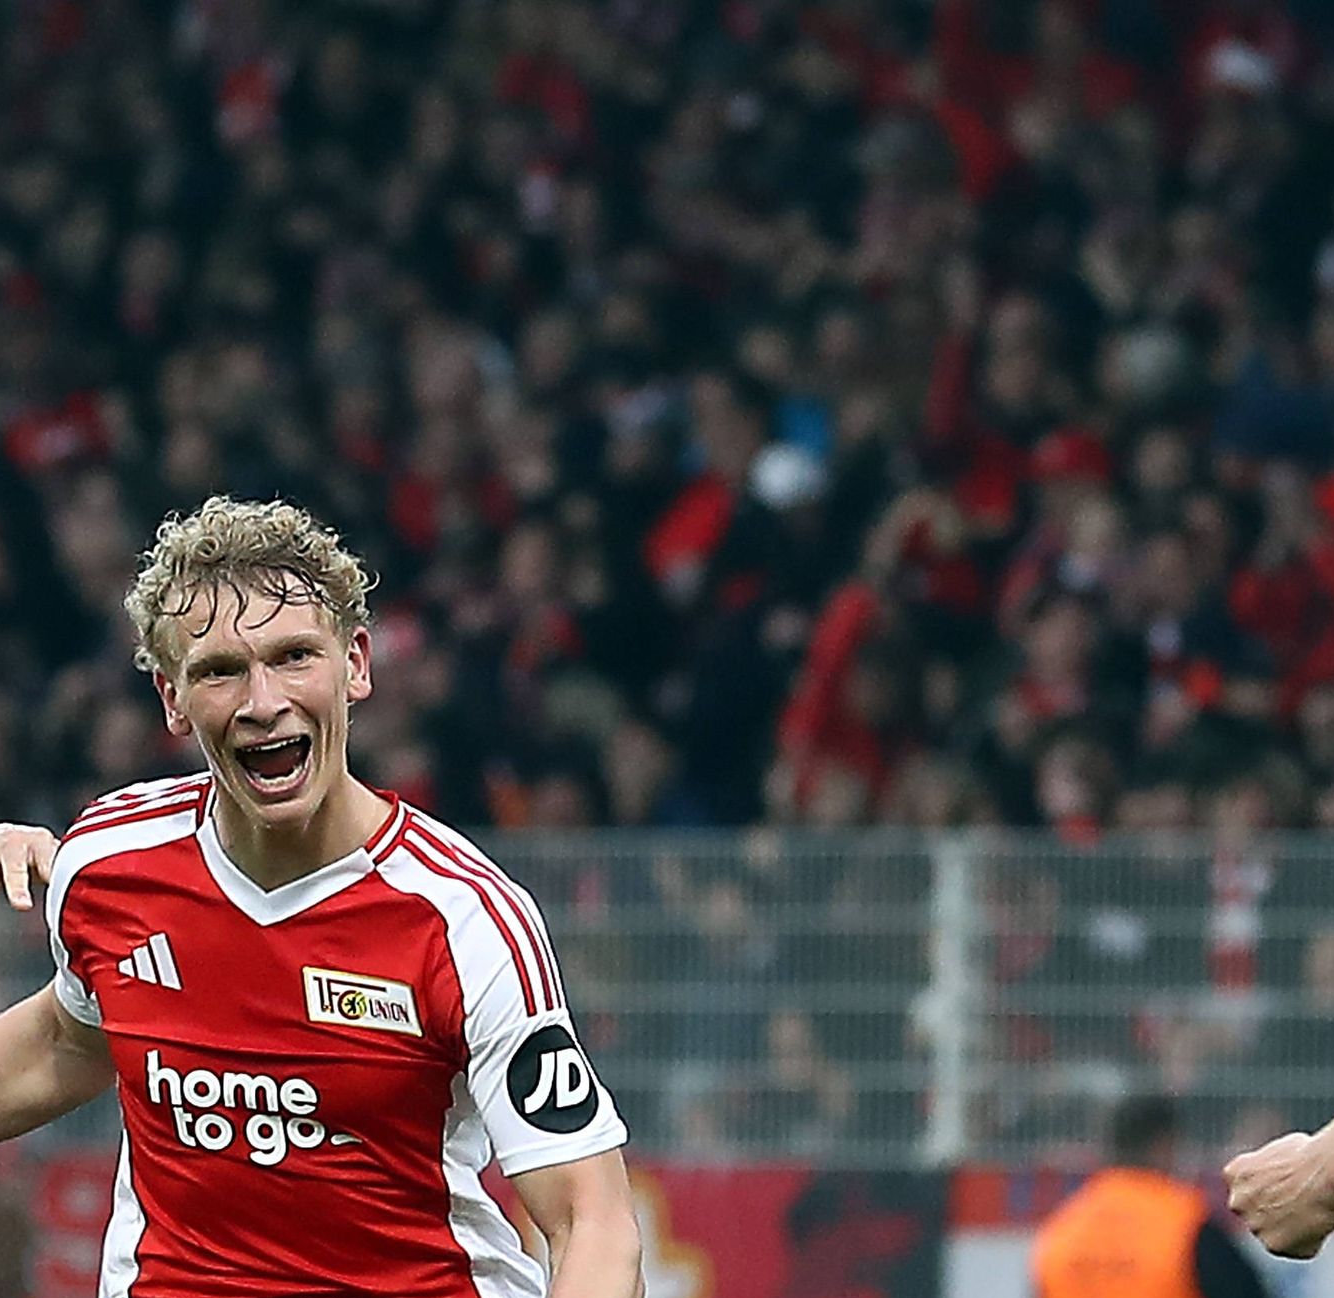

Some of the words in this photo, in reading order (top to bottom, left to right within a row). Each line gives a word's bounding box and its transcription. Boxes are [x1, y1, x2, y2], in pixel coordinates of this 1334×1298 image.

[146, 1049, 318, 1115] home
[523, 1047, 591, 1114] JD
[173, 1106, 234, 1151] to
